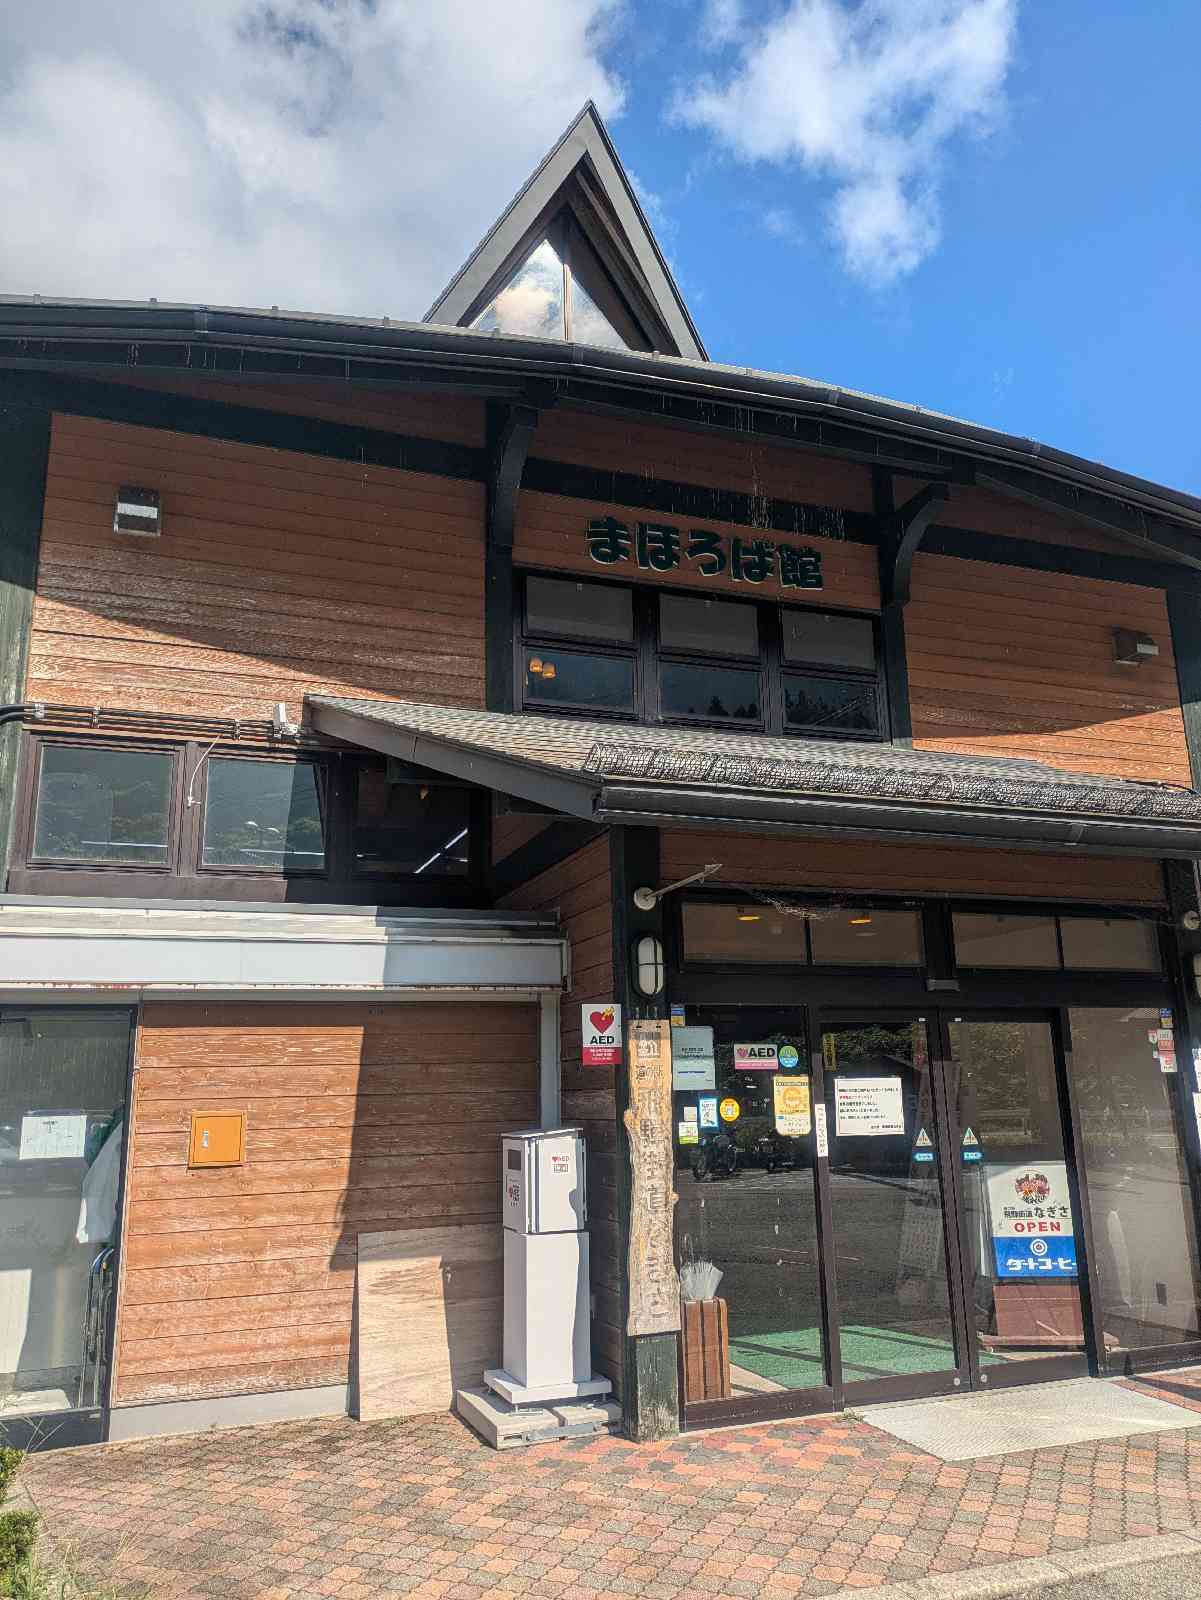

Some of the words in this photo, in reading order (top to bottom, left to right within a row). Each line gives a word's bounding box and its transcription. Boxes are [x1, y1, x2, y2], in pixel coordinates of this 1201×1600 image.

[585, 517, 823, 591] まほろば館
[590, 1035, 615, 1044] AED
[748, 1047, 776, 1057] AED
[1014, 1221, 1061, 1232] OPEN
